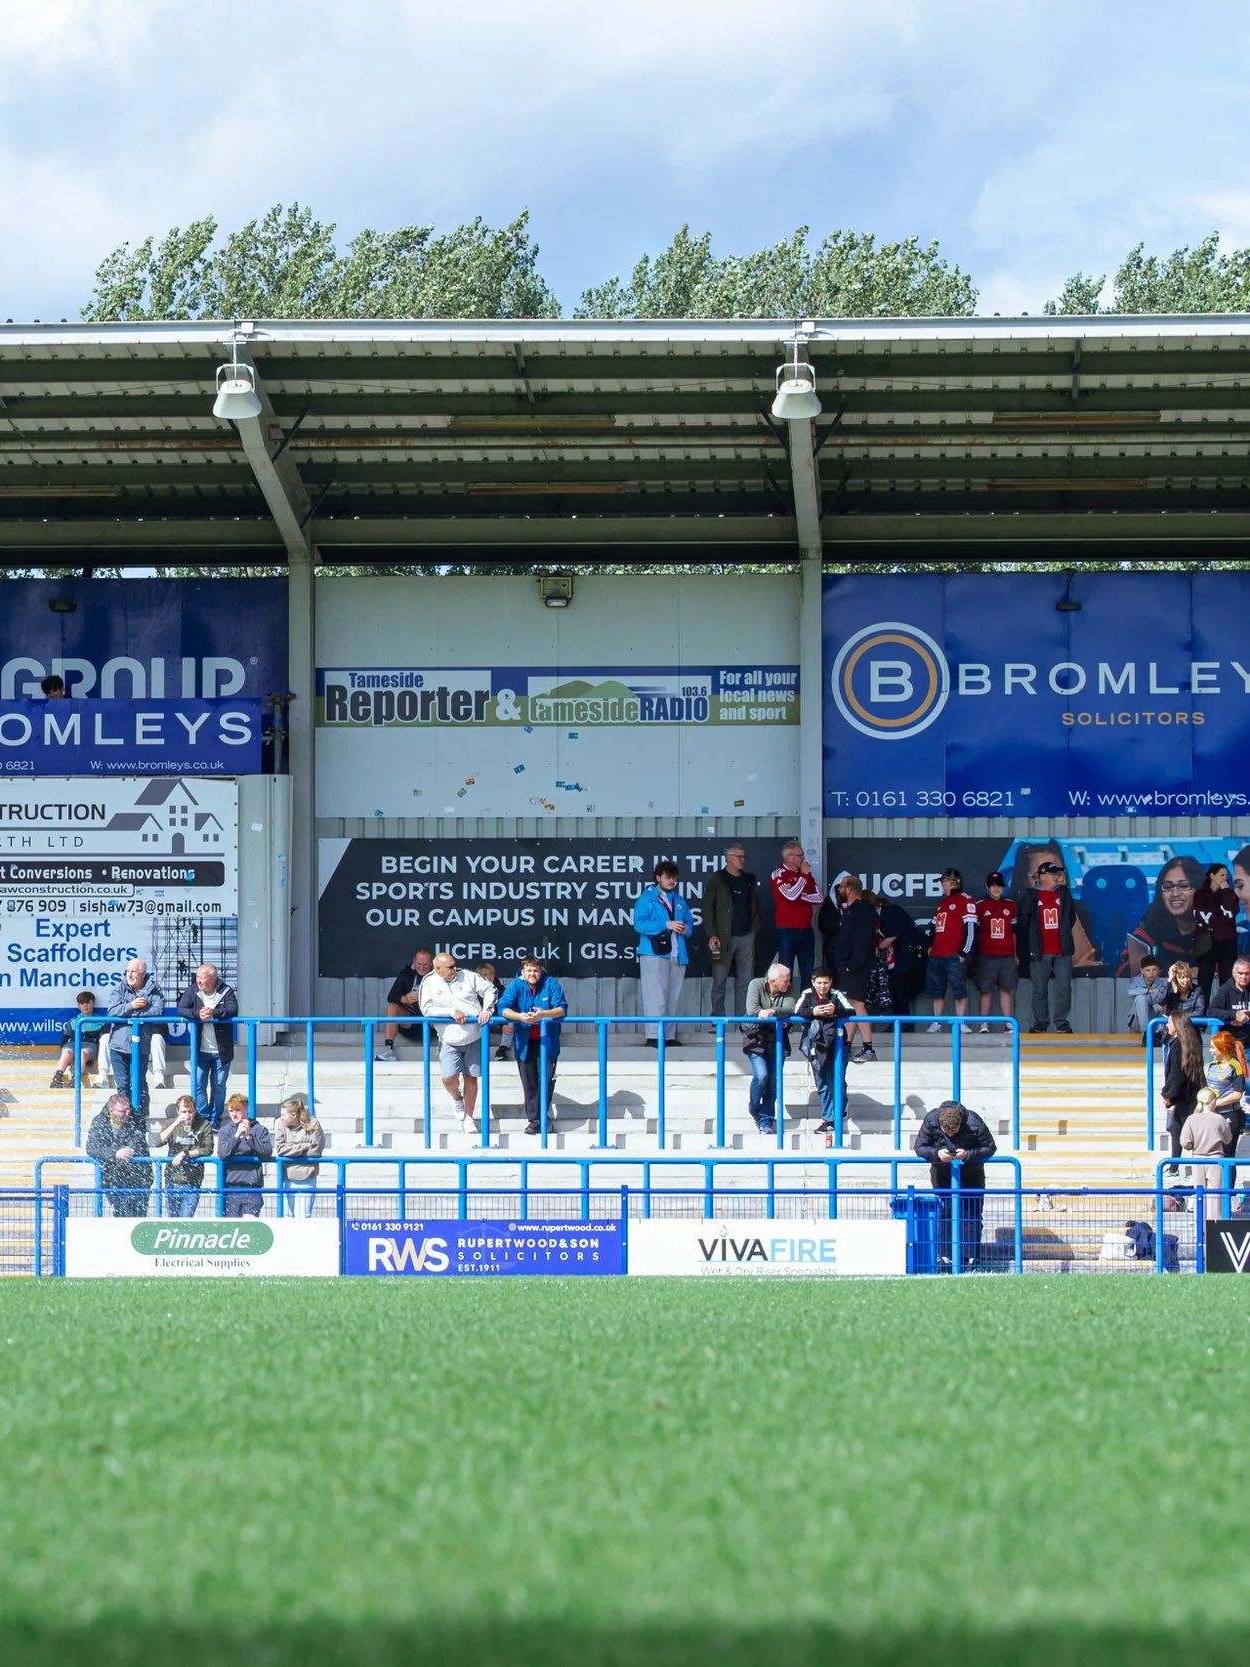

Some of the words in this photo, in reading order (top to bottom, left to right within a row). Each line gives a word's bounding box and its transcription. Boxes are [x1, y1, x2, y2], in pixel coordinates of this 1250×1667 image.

[350, 672, 424, 688] Tameside
[720, 671, 742, 685] For
[744, 671, 762, 685] all
[765, 672, 797, 688] your
[870, 660, 914, 702] B
[681, 686, 706, 696] 103.6
[720, 689, 754, 702] local
[757, 690, 795, 702] news
[326, 685, 490, 724] Reporter
[496, 689, 521, 720] &
[720, 706, 746, 720] and
[749, 706, 787, 724] sport
[1062, 712, 1205, 726] SOLICITORS
[5, 761, 34, 770] 6821
[90, 760, 102, 770] W:
[106, 760, 224, 772] www.bromleys.co.uk
[832, 792, 849, 806] T:
[856, 792, 906, 806] 0161
[916, 792, 956, 806] 330
[962, 792, 1014, 806] 6821
[1069, 790, 1090, 806] W:
[48, 836, 84, 847] LTD
[10, 866, 92, 879] Conversions
[112, 866, 194, 879] Renovations
[382, 856, 458, 873] BEGIN
[464, 856, 537, 873] YOUR
[544, 856, 644, 873] CAREER
[356, 883, 453, 900] SPORTS
[463, 882, 586, 899] INDUSTRY
[858, 873, 943, 897] UCFB
[7, 900, 34, 912] 876
[38, 900, 66, 912] 909
[80, 900, 221, 914] sishaw73@gmail.com
[366, 908, 420, 926] OUR
[428, 908, 535, 926] CAMPUS
[544, 908, 568, 926] IN
[36, 918, 110, 941] Expert
[7, 943, 138, 962] Scaffolders
[362, 1223, 382, 1231] 0161
[385, 1223, 400, 1231] 330
[402, 1223, 424, 1231] 9121
[518, 1224, 616, 1234] www.rupertwood.co.uk
[154, 1228, 250, 1249] Pinnacle
[369, 1238, 449, 1272] RWS
[458, 1252, 599, 1260] SOLICITORS
[155, 1258, 203, 1268] Electrical
[206, 1258, 250, 1270] Supplies
